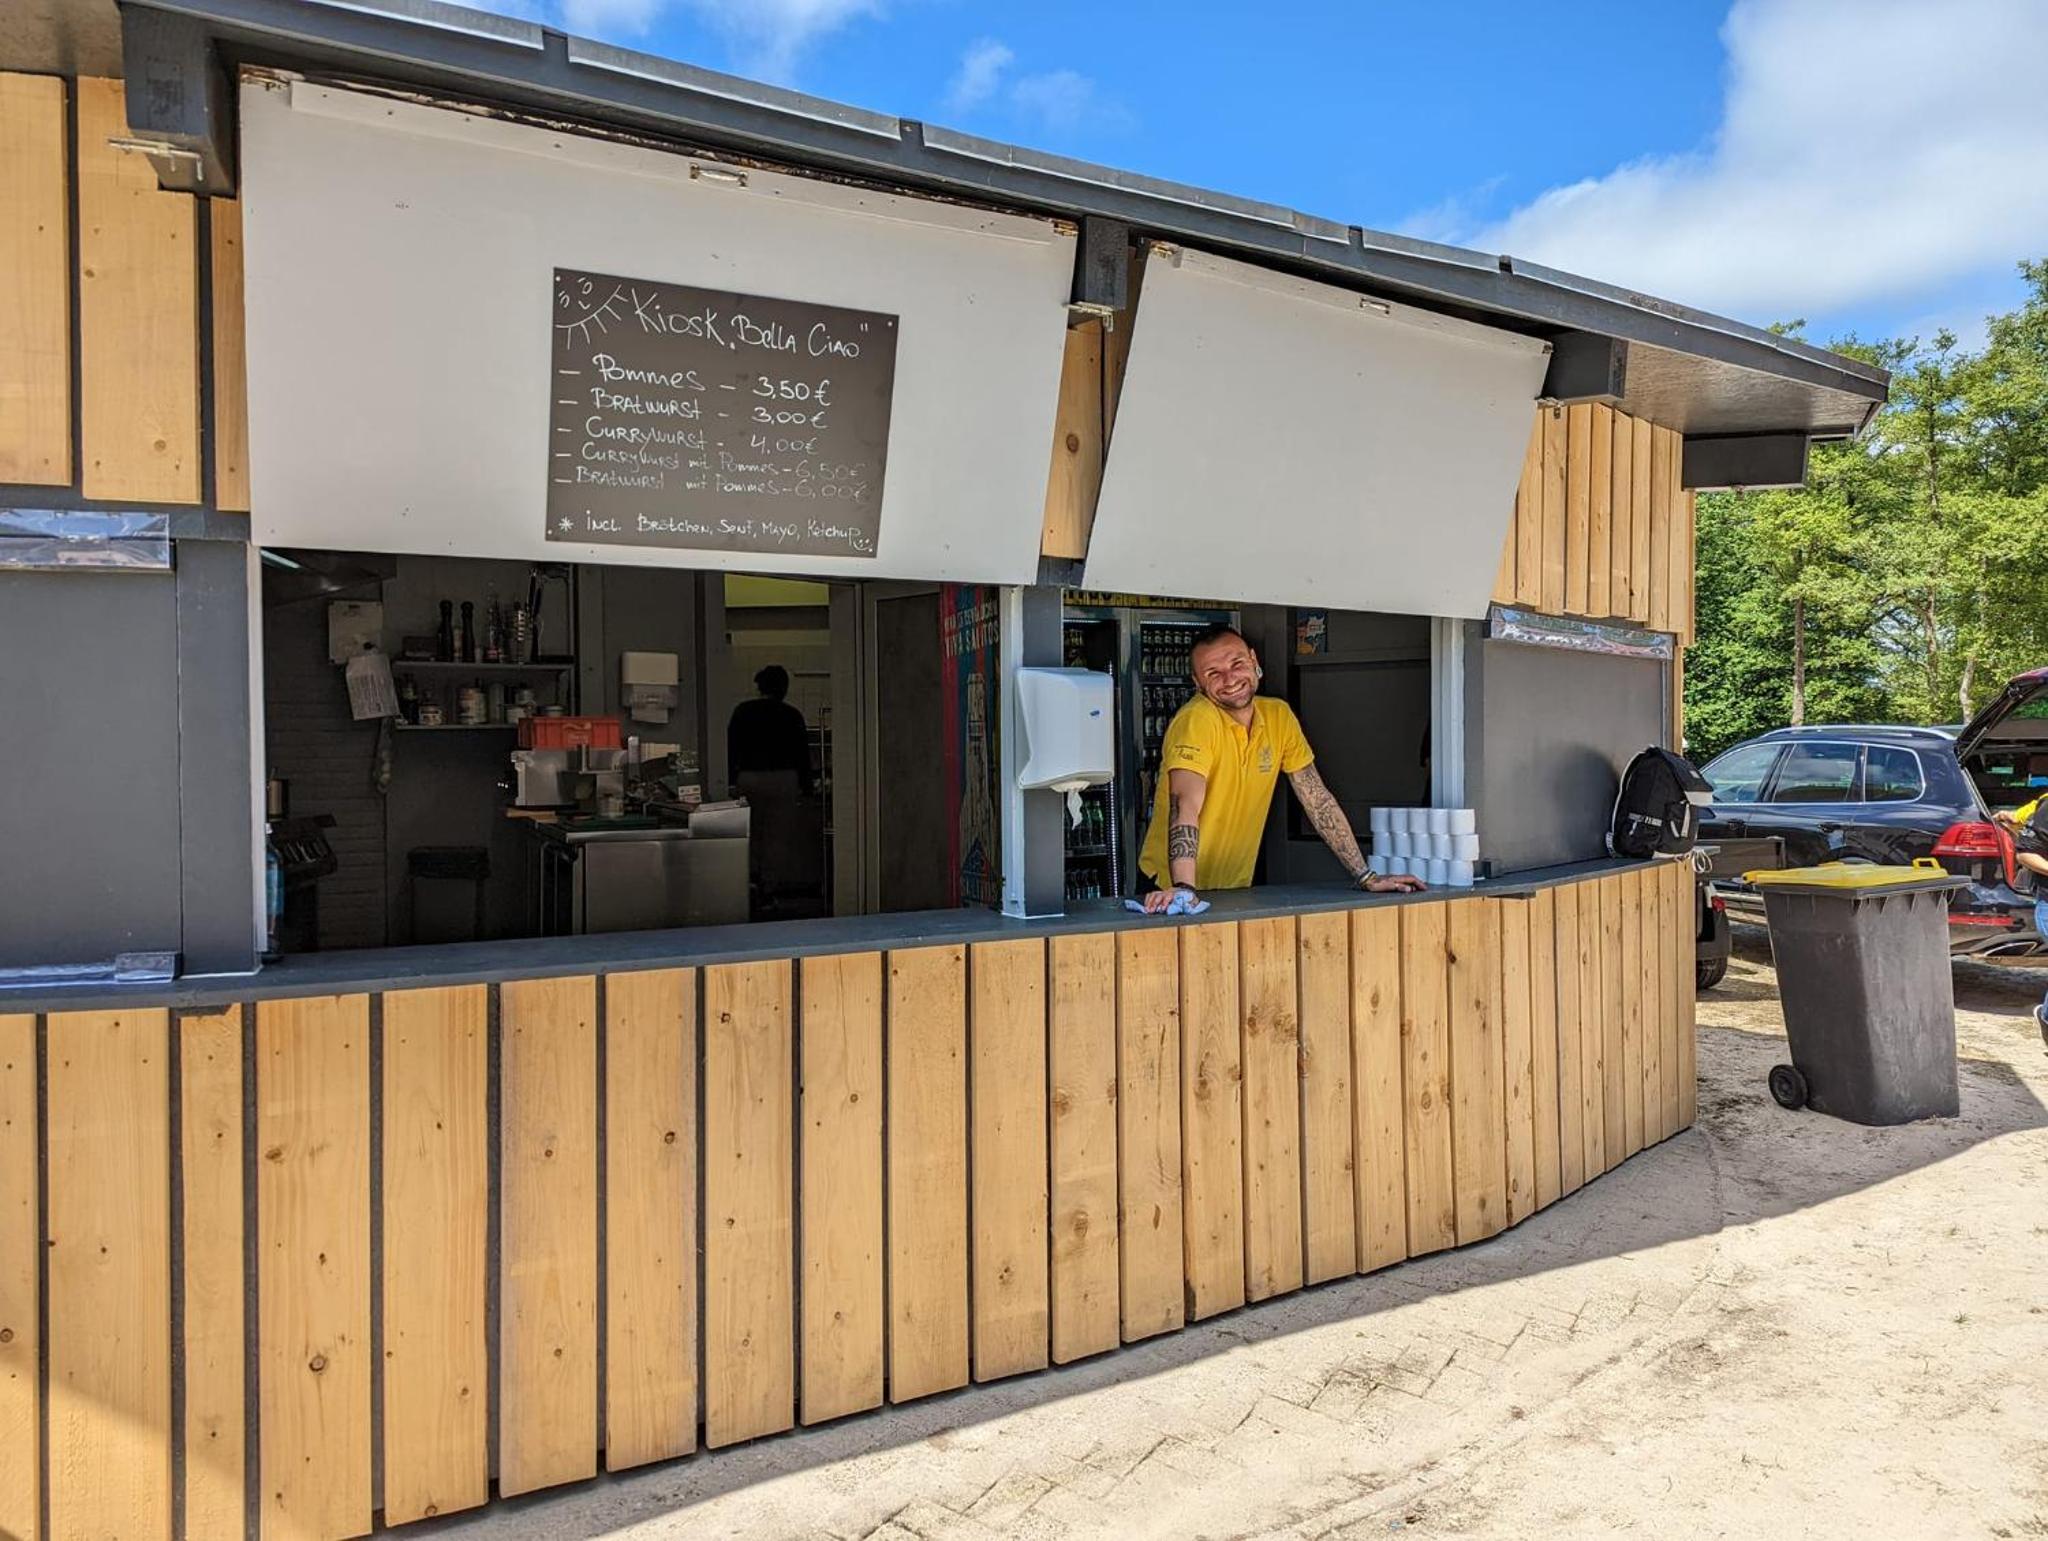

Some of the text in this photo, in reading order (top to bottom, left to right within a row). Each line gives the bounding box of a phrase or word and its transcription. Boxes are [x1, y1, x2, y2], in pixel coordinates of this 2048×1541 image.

[592, 353, 706, 391] Pommes
[688, 453, 712, 469] mit
[718, 451, 780, 475] Pommes
[686, 473, 708, 490] mit
[715, 473, 780, 495] Pommes
